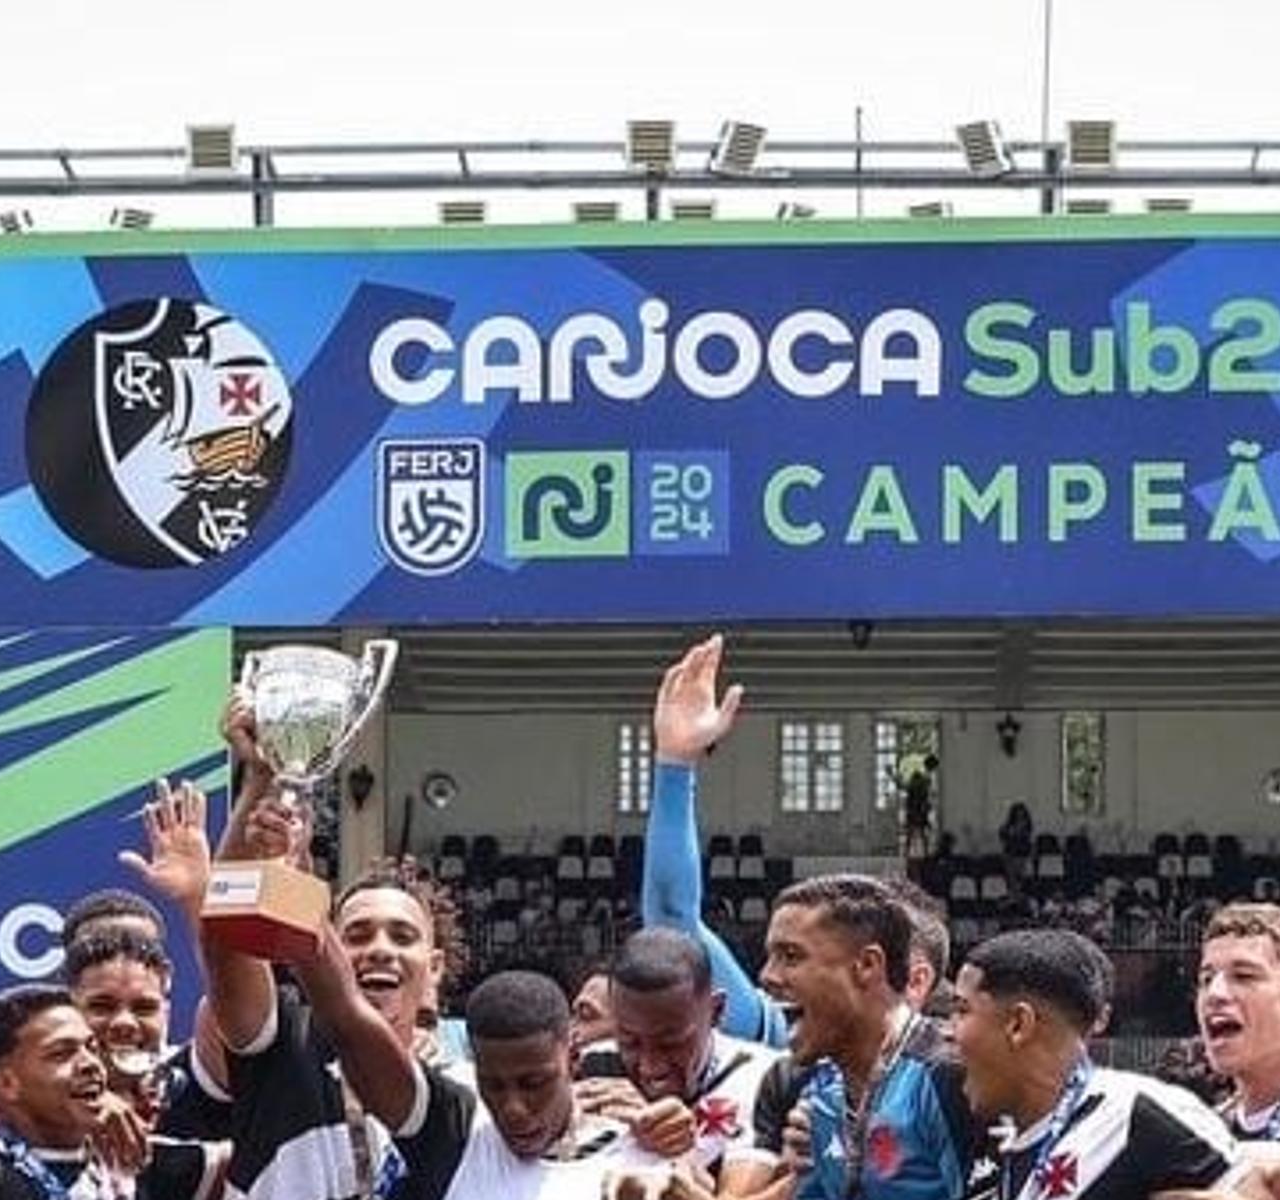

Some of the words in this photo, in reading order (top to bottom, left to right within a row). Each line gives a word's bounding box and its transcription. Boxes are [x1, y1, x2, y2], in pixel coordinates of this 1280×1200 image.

[370, 299, 941, 405] CARIOCA
[390, 451, 474, 477] FERJ
[650, 465, 712, 500] 20
[650, 505, 714, 540] 24
